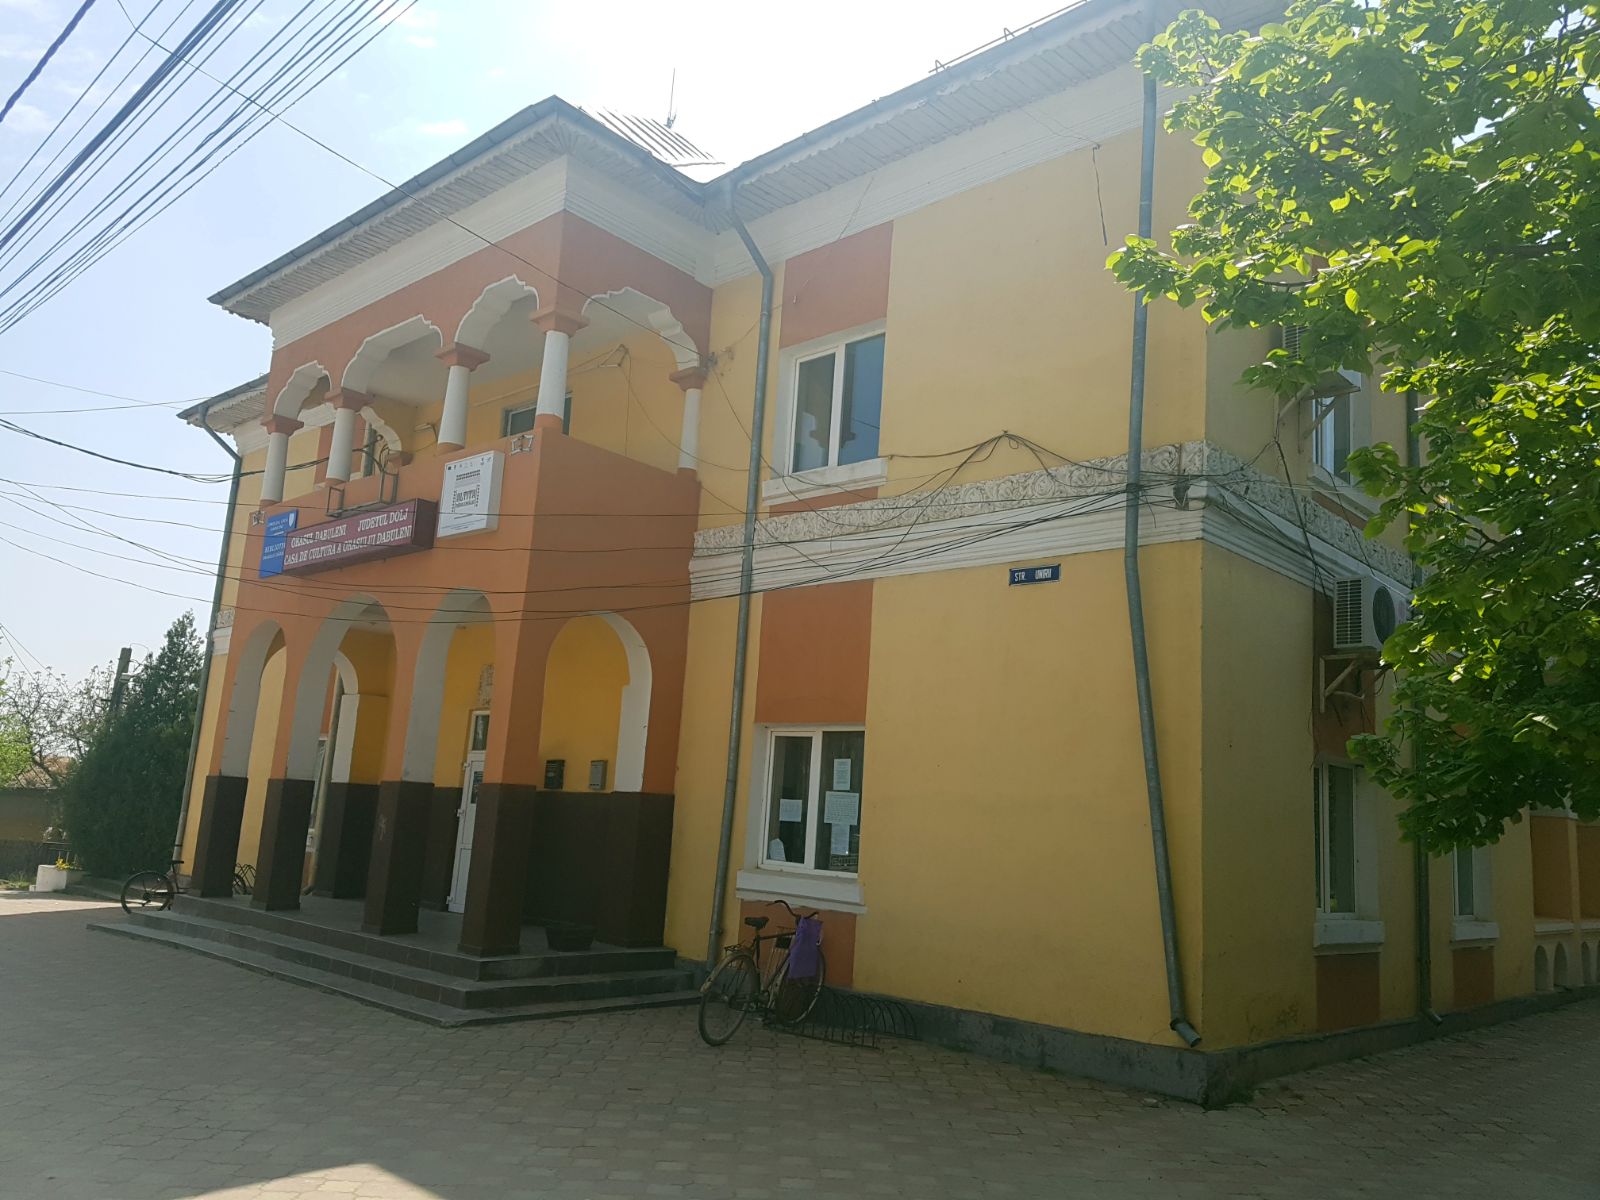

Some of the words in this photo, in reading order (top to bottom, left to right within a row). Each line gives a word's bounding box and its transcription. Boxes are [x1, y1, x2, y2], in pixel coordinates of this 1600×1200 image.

[389, 508, 409, 524] DOLJ
[284, 552, 299, 565] CASA
[299, 550, 308, 562] DE
[336, 543, 342, 554] A
